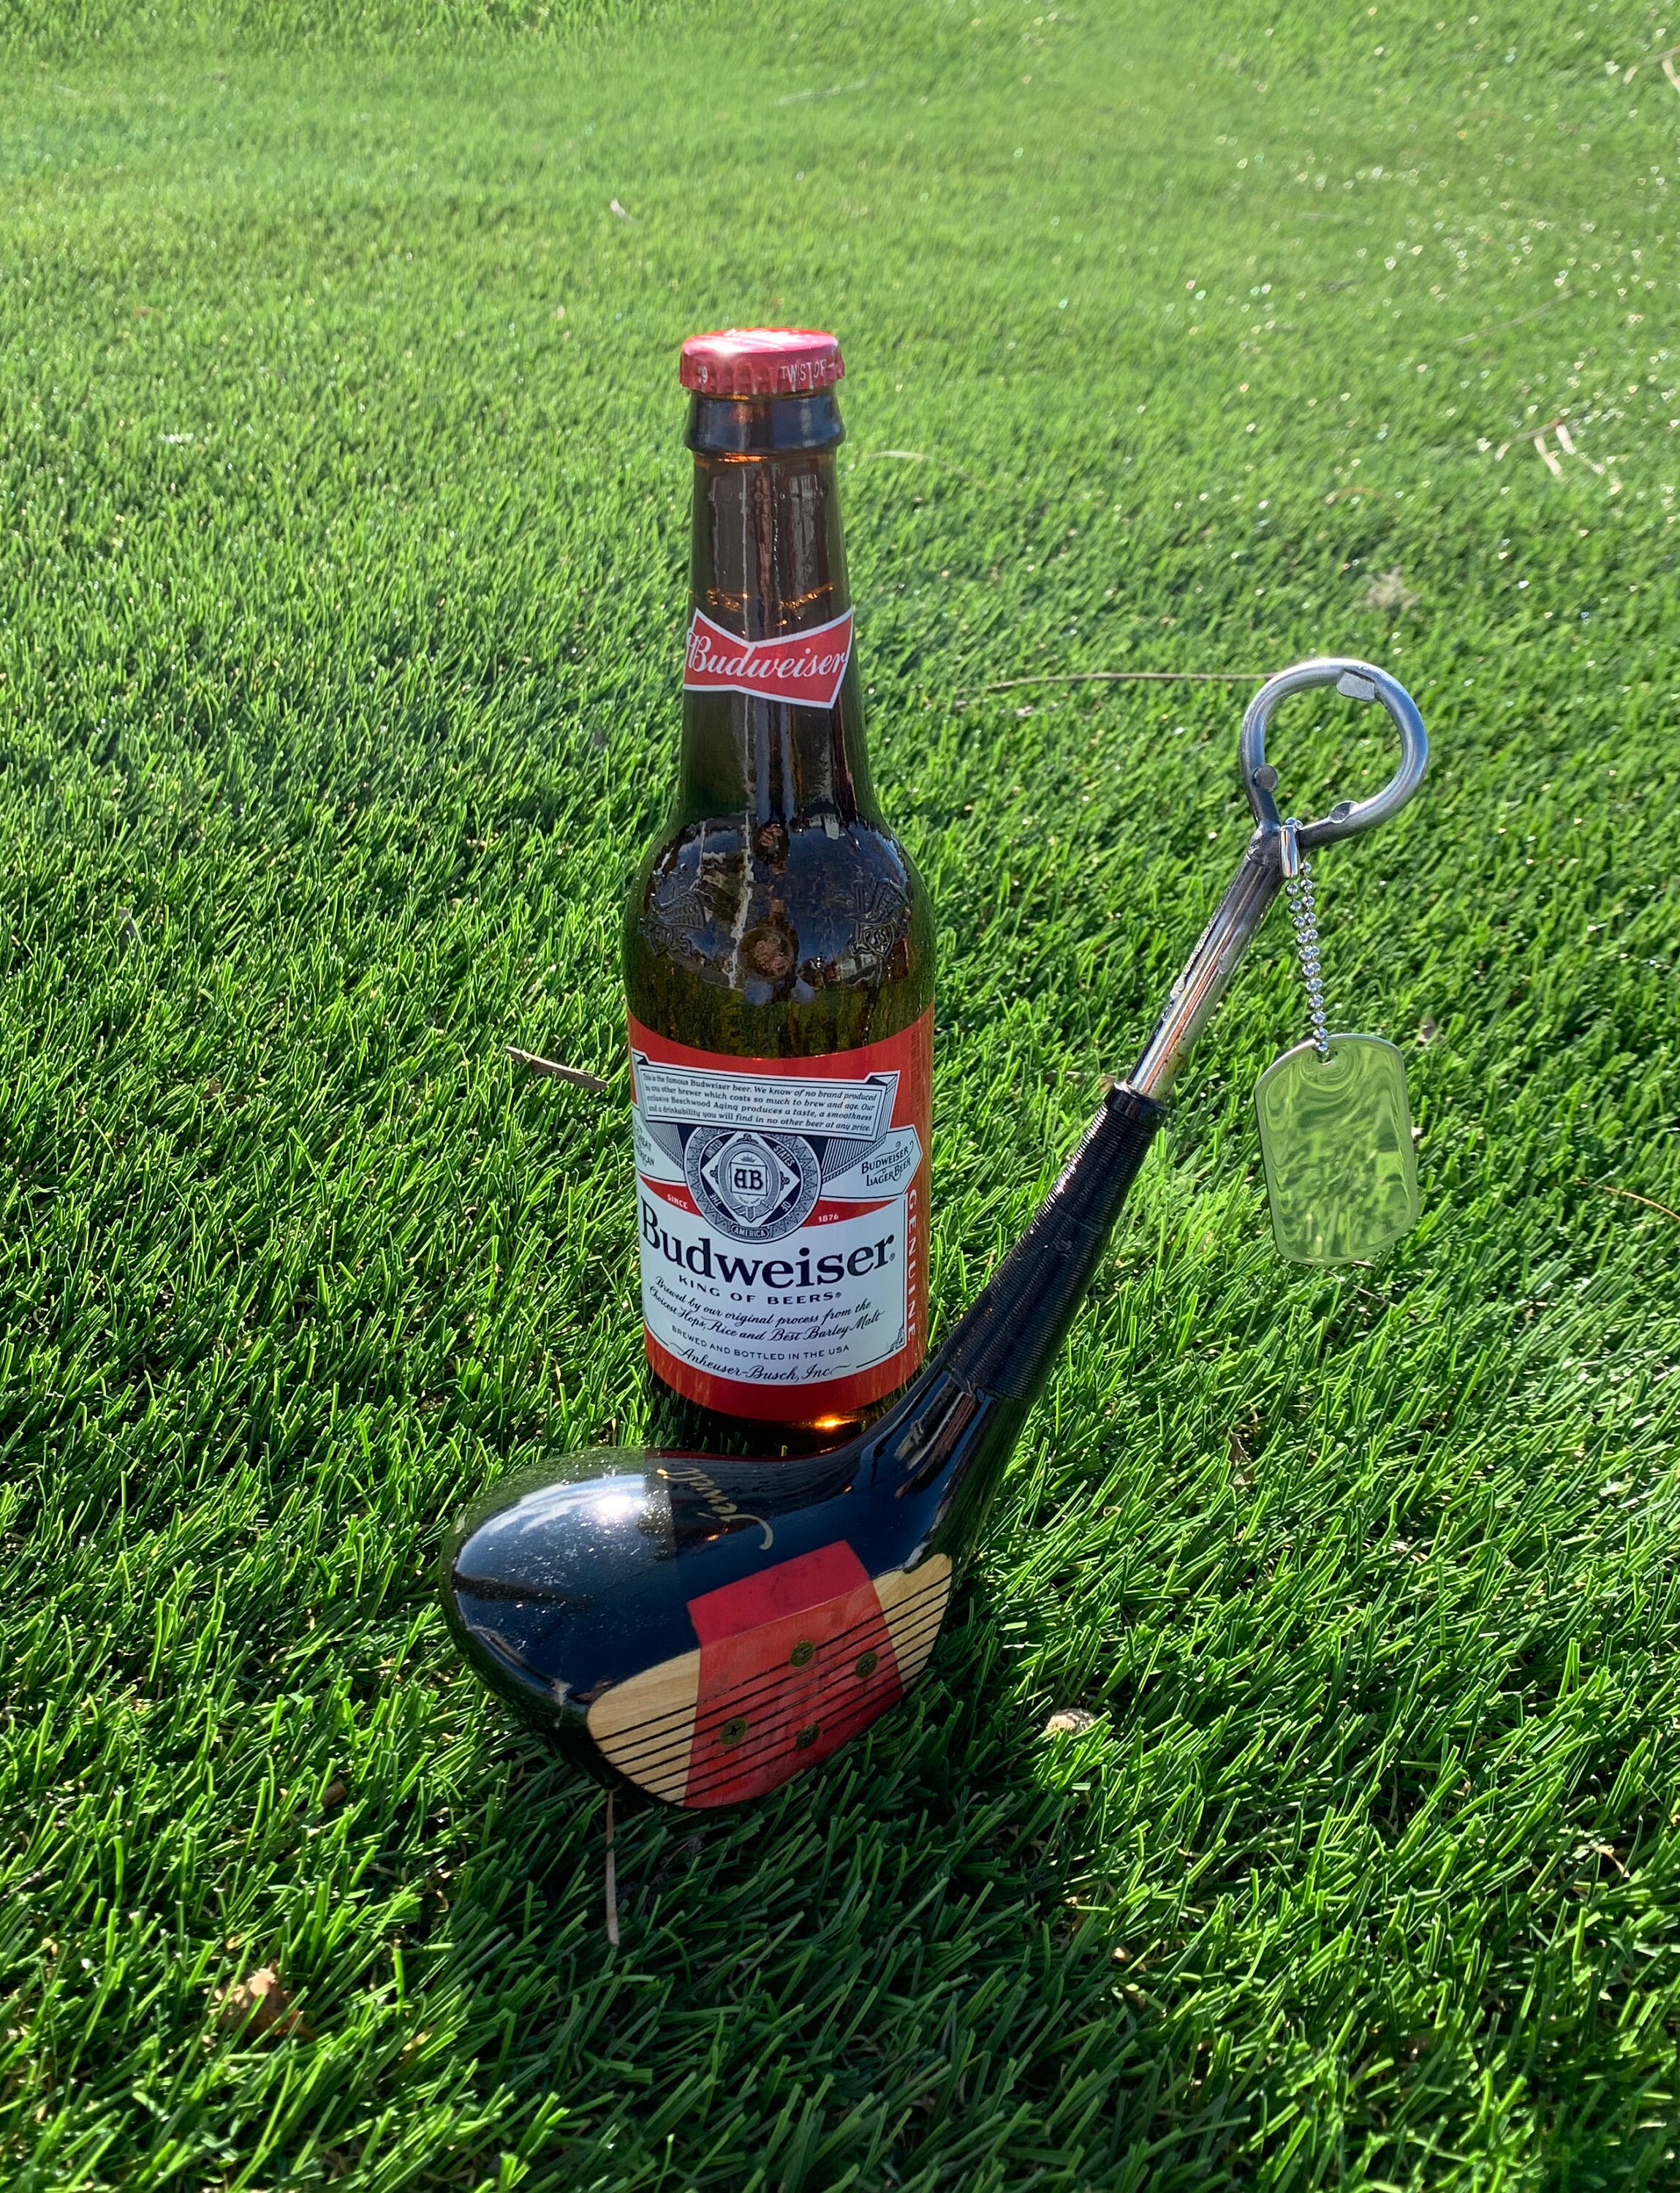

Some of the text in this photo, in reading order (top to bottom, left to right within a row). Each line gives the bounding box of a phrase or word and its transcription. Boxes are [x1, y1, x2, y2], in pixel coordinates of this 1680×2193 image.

[688, 632, 847, 679] Budweiser
[657, 1075, 665, 1083] the
[666, 1076, 689, 1086] famous
[690, 1079, 730, 1091] Budweiser
[733, 1084, 753, 1093] beer.
[754, 1086, 766, 1094] We
[769, 1086, 792, 1096] know
[794, 1088, 805, 1098] of
[818, 1090, 841, 1099] brand
[844, 1092, 877, 1102] produced
[661, 1085, 676, 1094] other
[678, 1087, 702, 1097] brewer
[704, 1090, 727, 1100] which
[730, 1094, 751, 1102] costs
[766, 1098, 790, 1106] much
[804, 1099, 826, 1107] brew
[827, 1099, 844, 1109] and
[844, 1102, 860, 1112] age.
[861, 1102, 875, 1111] Our
[662, 1105, 701, 1118] drinkability
[703, 1110, 716, 1118] you
[719, 1112, 733, 1121] will
[735, 1113, 753, 1122] find
[755, 1116, 764, 1124] in
[780, 1117, 803, 1126] other
[806, 1119, 824, 1128] beer
[836, 1122, 850, 1131] any
[851, 1124, 871, 1132] price.
[671, 1096, 711, 1108] Beechwood
[714, 1102, 738, 1112] Aging
[741, 1105, 782, 1116] produces
[792, 1107, 817, 1118] taste,
[827, 1111, 873, 1121] smoothness
[704, 1140, 724, 1159] UNITED
[773, 1145, 795, 1167] STATES
[861, 1145, 909, 1175] BUDWEISER
[733, 1168, 763, 1190] AB
[866, 1156, 911, 1187] LAGER BEER
[666, 1193, 689, 1210] SINCE
[708, 1192, 722, 1207] THE
[782, 1200, 792, 1212] OF
[817, 1213, 839, 1224] 1876
[733, 1227, 766, 1238] AMERICA
[908, 1188, 917, 1341] GENUINE
[656, 1275, 871, 1328] Brewed by our original process from the
[678, 1274, 721, 1298] KING
[730, 1292, 757, 1303] OF
[648, 1284, 885, 1341] Choicest Hops, Rice and Best Barley Malt
[671, 1325, 850, 1361] BREWED AND BOTTLED IN THE USA
[671, 1344, 800, 1383] Anheuser-Busch,
